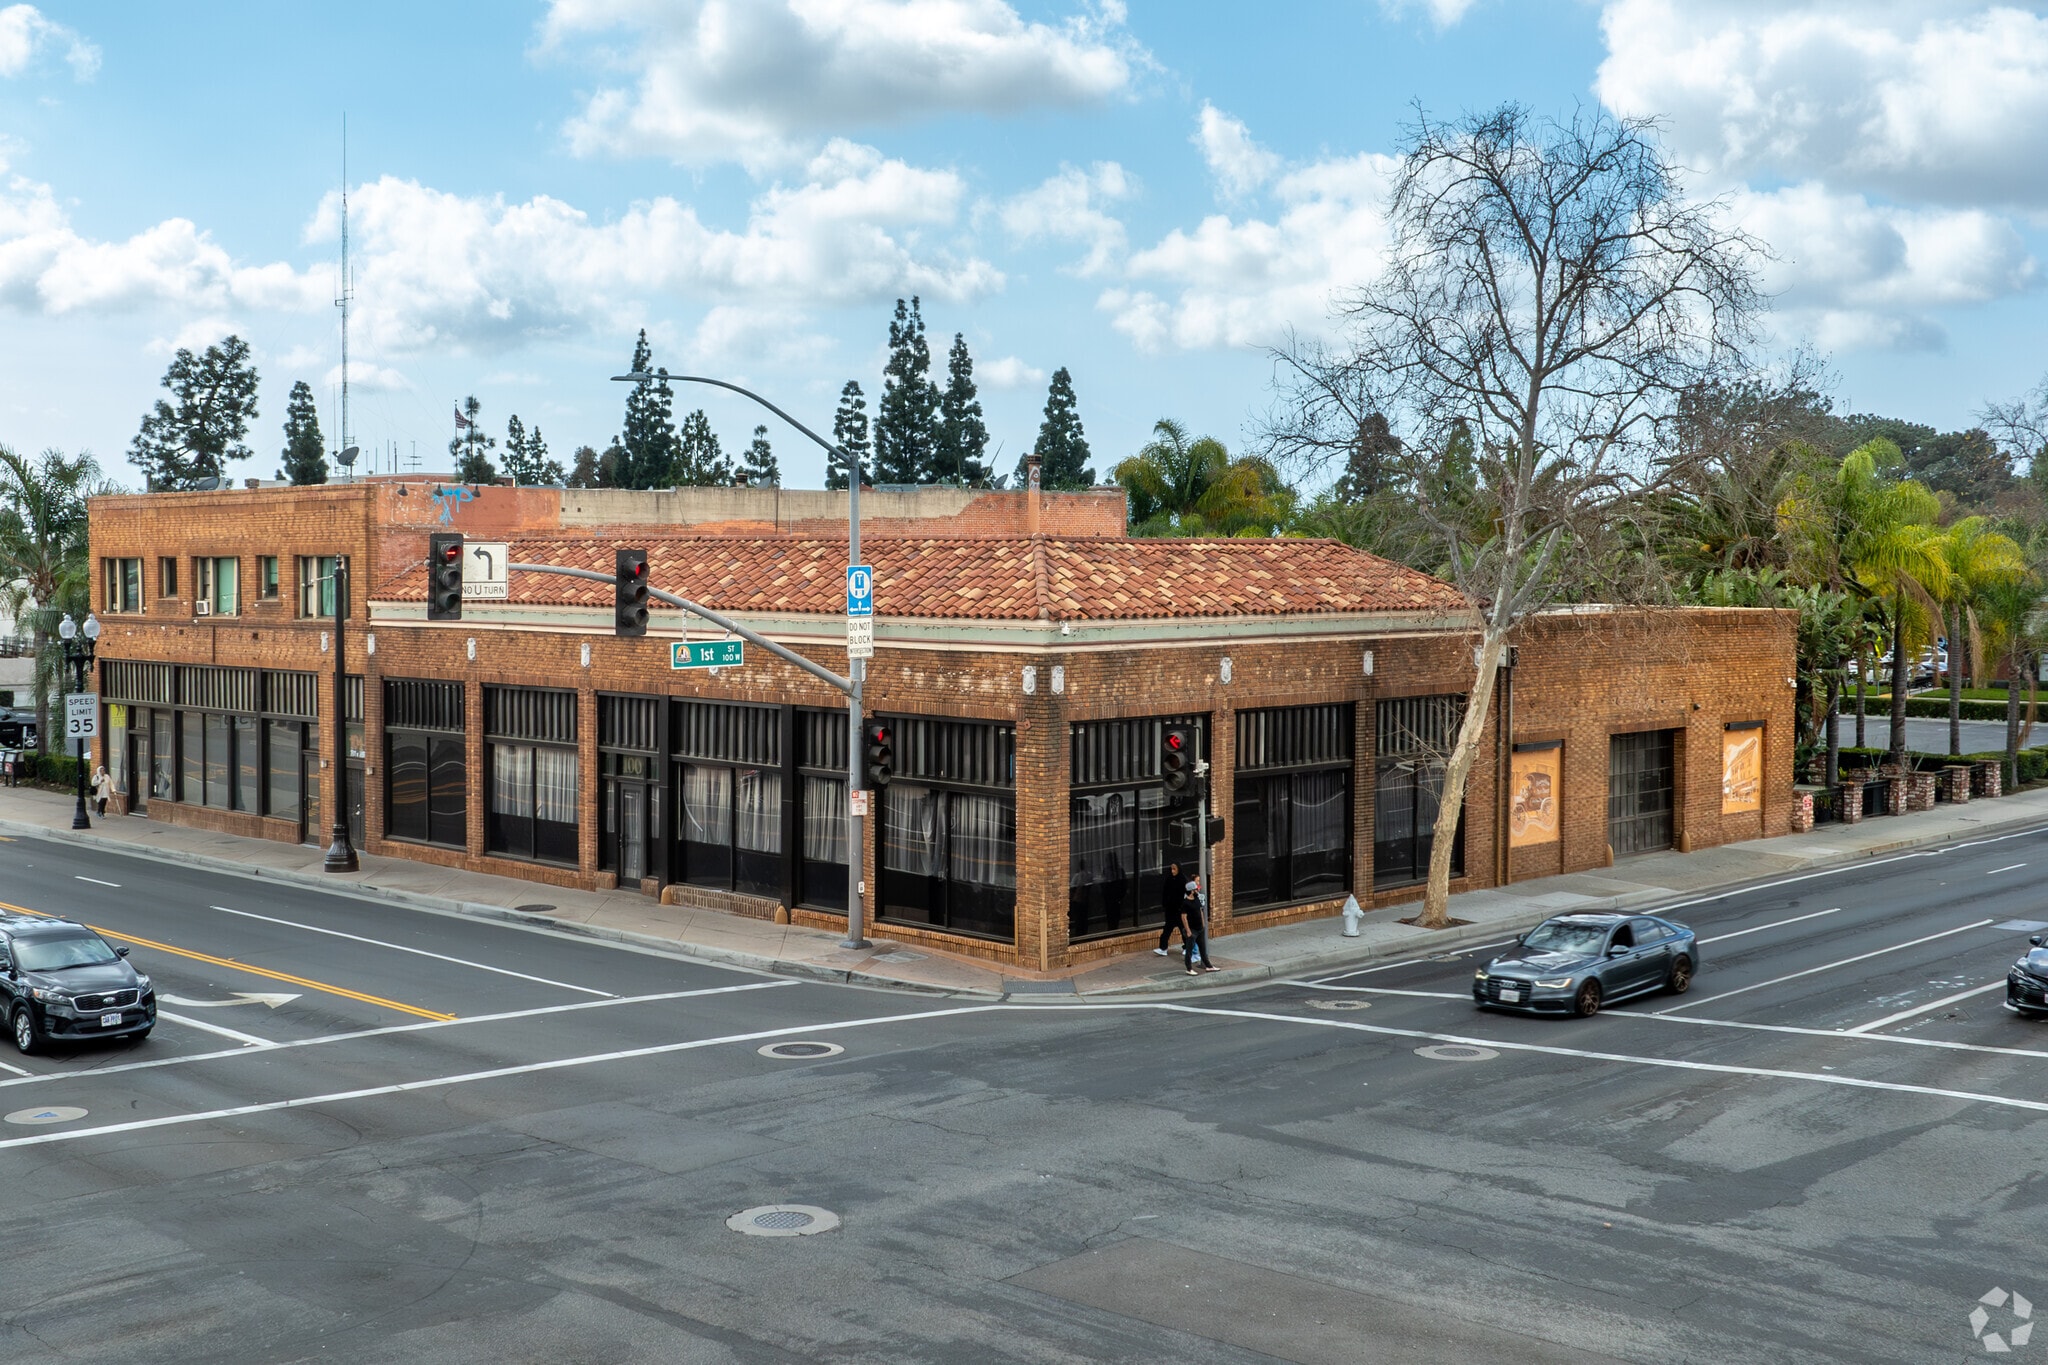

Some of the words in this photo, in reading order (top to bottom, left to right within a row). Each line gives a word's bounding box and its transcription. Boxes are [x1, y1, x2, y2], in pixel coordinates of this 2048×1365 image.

[462, 586, 473, 595] NO
[474, 584, 482, 596] U
[484, 585, 505, 595] TURN
[849, 622, 858, 632] DO
[859, 621, 871, 631] NOT
[849, 635, 871, 645] BLOCK
[700, 647, 714, 661] 1st
[722, 653, 734, 662] 100
[735, 653, 741, 661] W
[68, 697, 96, 706] SPEED
[71, 708, 92, 716] LIMIT
[70, 718, 94, 733] 35
[622, 756, 642, 775] 100
